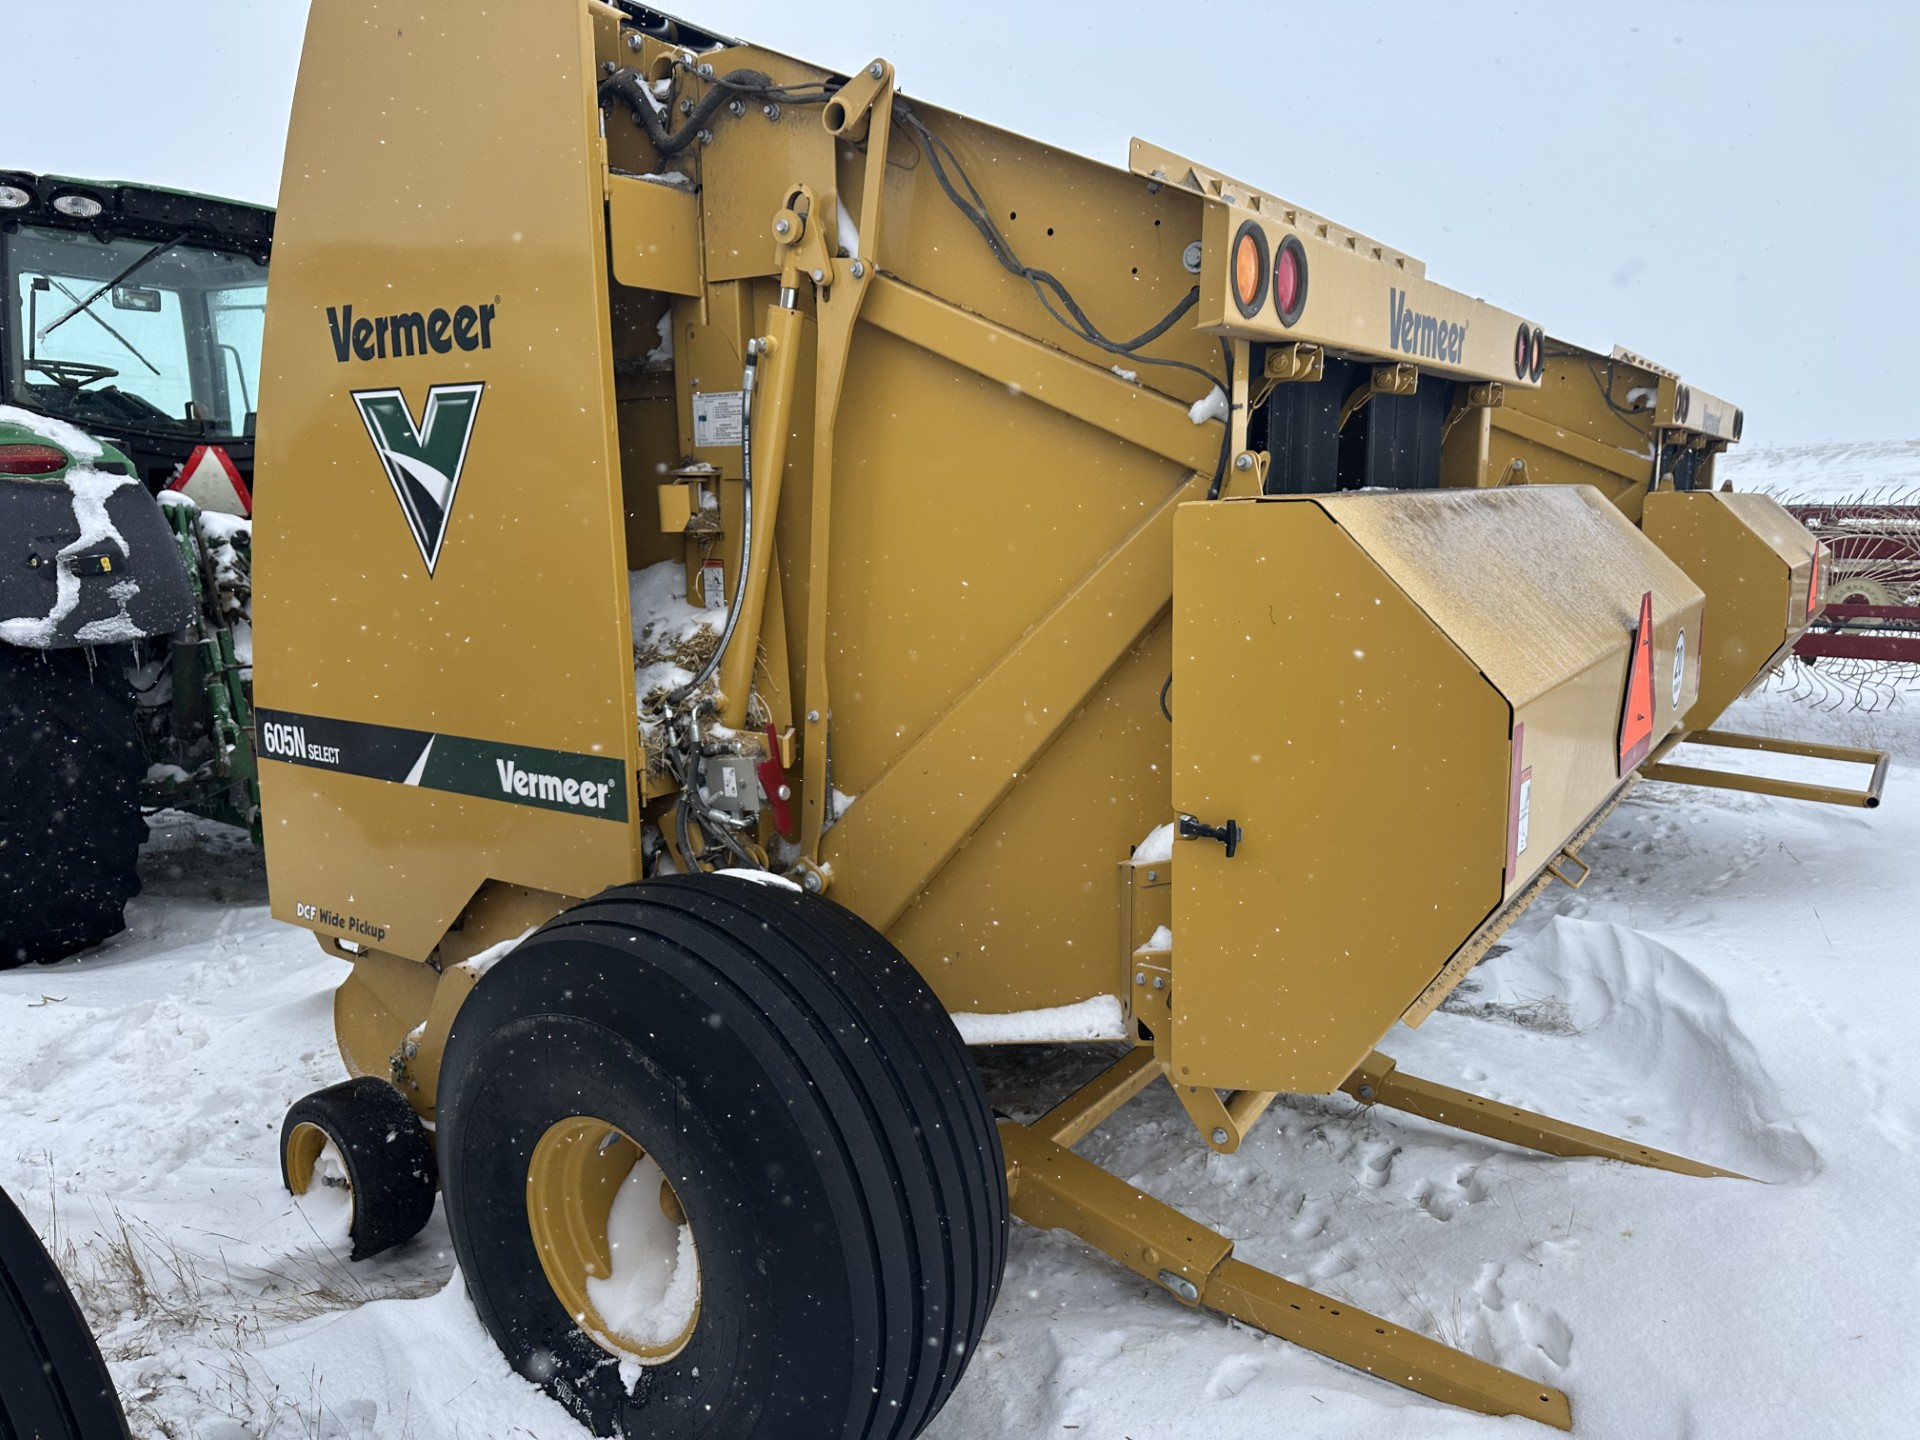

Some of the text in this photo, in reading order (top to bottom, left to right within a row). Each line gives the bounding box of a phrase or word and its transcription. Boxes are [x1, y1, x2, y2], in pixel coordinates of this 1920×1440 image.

[264, 721, 340, 765] 605N SELECT
[296, 901, 386, 942] DCF Wide Pickup
